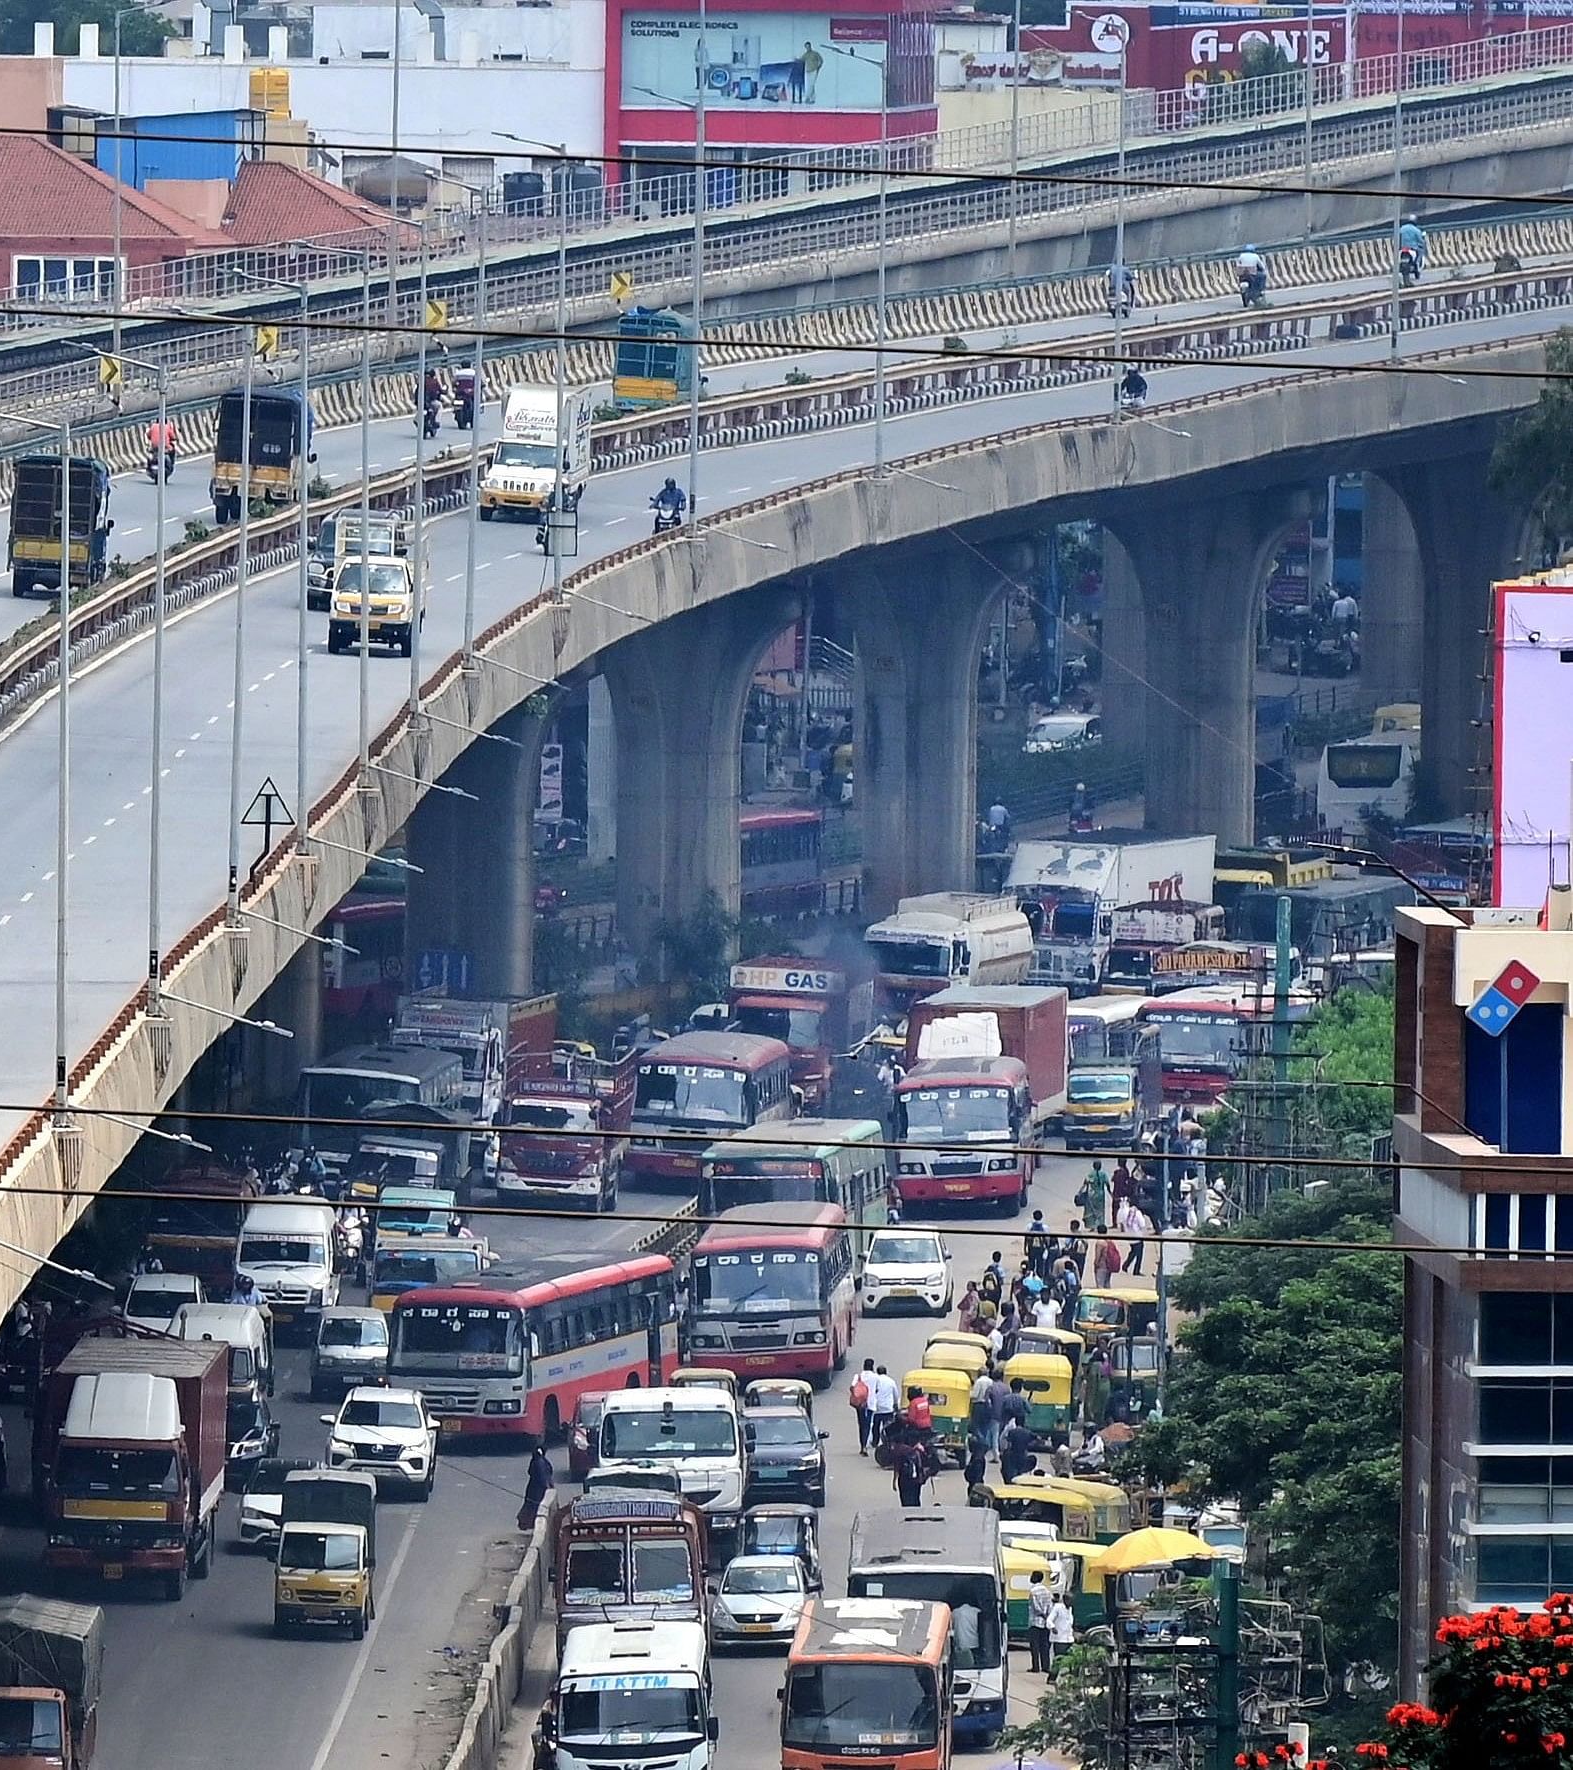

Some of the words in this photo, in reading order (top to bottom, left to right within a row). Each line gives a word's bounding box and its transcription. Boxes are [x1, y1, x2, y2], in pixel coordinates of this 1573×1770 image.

[630, 20, 676, 30] COMPLETE
[678, 20, 738, 30] ELECRONICS
[630, 28, 680, 38] SOLUTIONS
[750, 969, 778, 985] HP
[784, 972, 828, 990] GAS
[616, 1676, 668, 1688] KTTM
